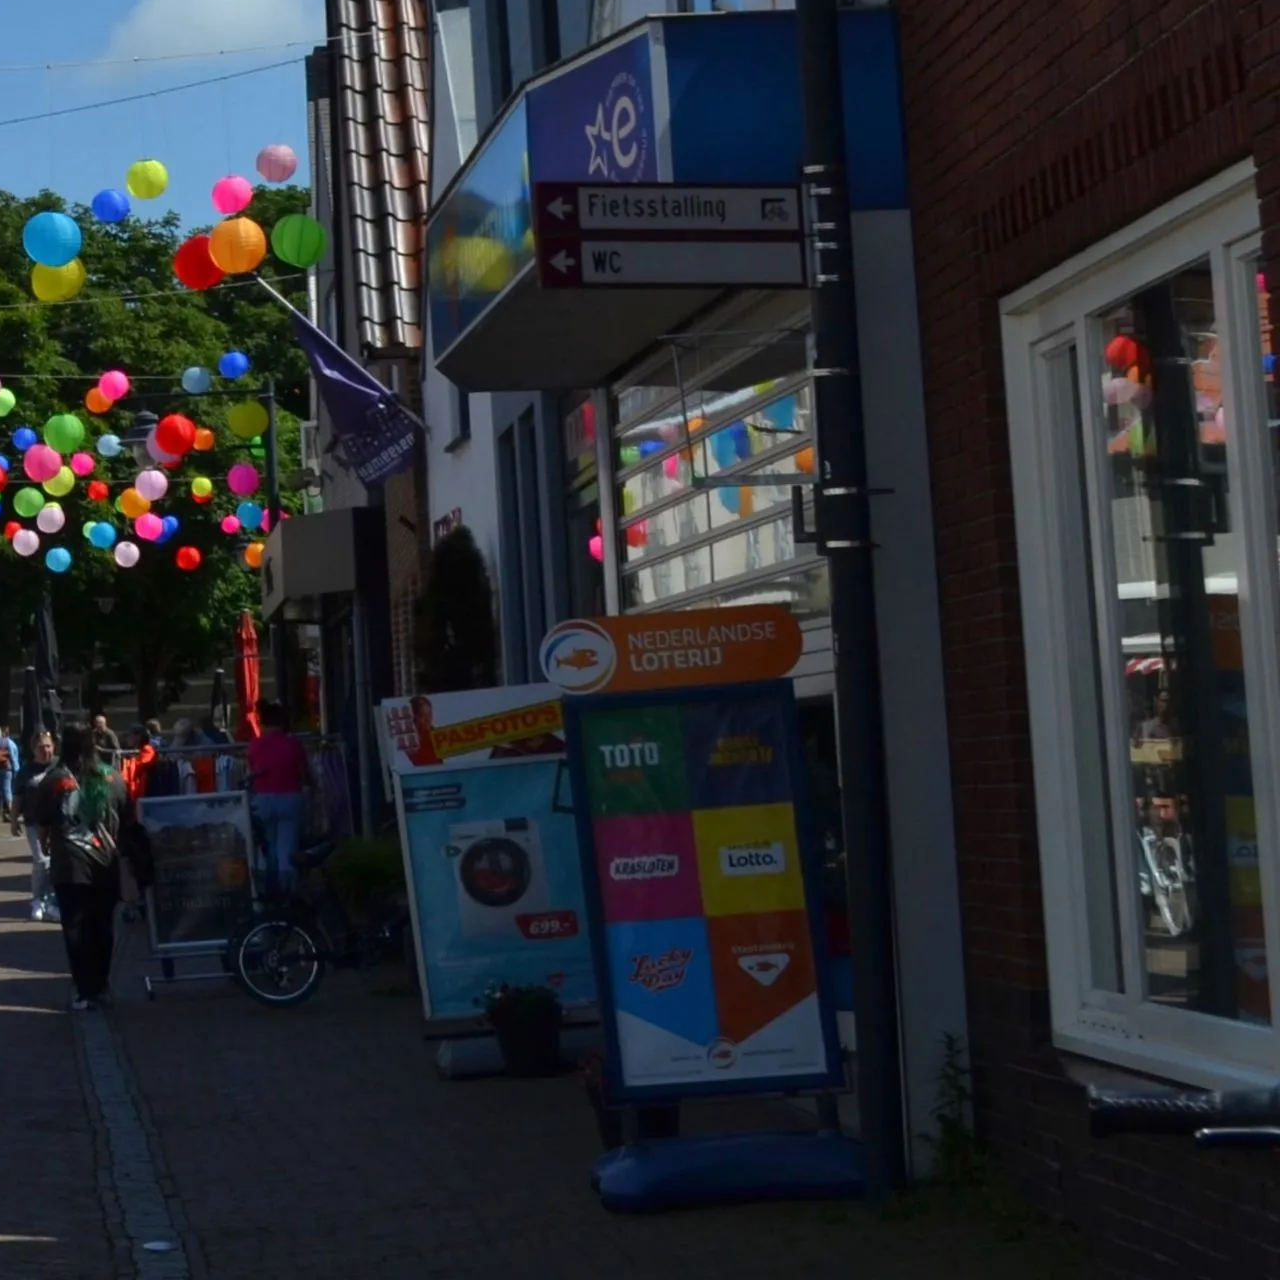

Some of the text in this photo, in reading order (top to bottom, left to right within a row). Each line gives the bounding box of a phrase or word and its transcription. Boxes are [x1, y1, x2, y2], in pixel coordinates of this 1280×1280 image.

[588, 194, 727, 223] Fietsstalling
[592, 251, 622, 273] WC
[628, 621, 777, 651] NEDERLANDSE
[630, 646, 723, 672] LOTERIJ
[434, 705, 559, 750] PASFOTO'S
[599, 741, 660, 768] TOTO
